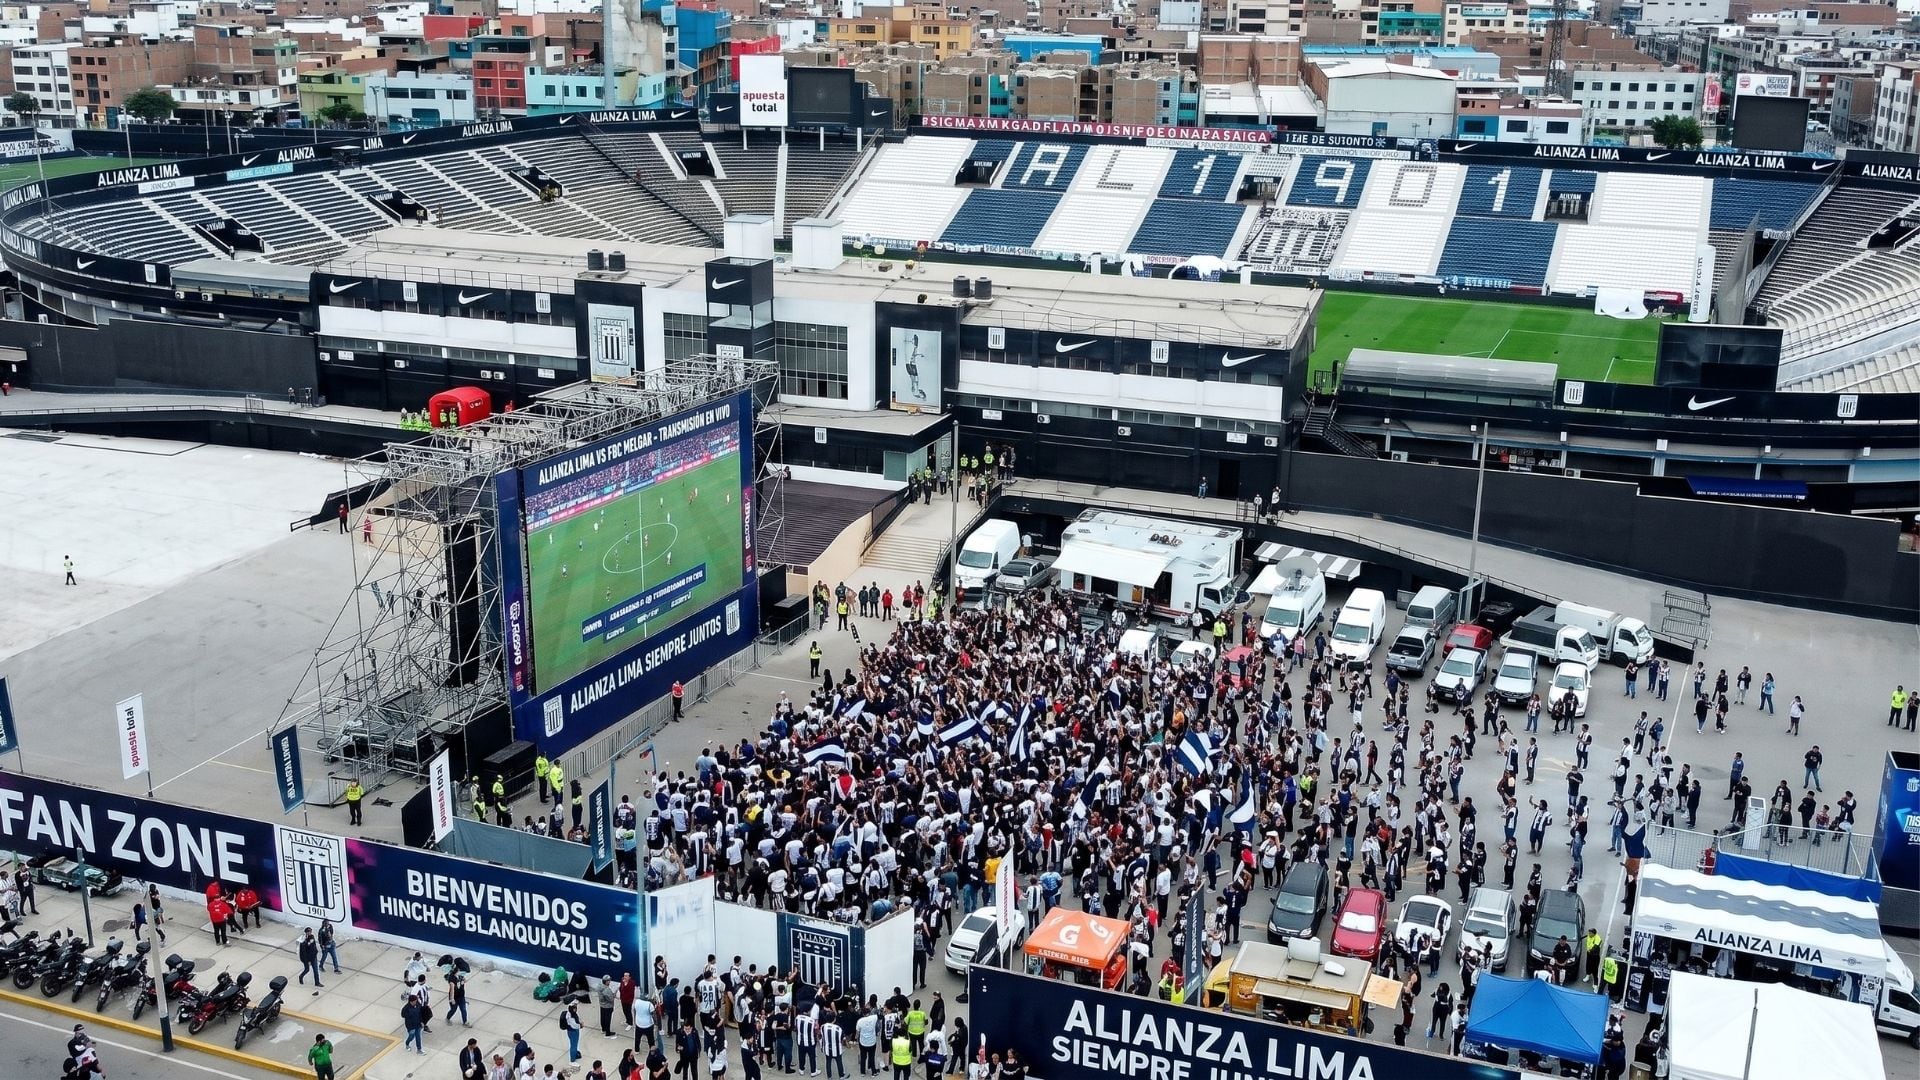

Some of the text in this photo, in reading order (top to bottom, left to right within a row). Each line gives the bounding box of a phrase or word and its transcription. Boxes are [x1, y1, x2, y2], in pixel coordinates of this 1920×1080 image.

[743, 91, 785, 102] apuesta
[590, 110, 657, 123] ALIANZA LIMA
[752, 103, 777, 112] total
[462, 120, 513, 138] ALIANZA LIMA
[278, 136, 383, 163] ALIANZA LIMA
[1534, 145, 1620, 160] ALIANZA LIMA
[1695, 153, 1785, 169] ALIANZA LIMA
[98, 167, 149, 187] ALIANZA
[152, 163, 180, 179] LIMA
[1862, 164, 1913, 180] ALIANZA
[23, 183, 42, 202] LIMA
[539, 459, 574, 486] ALIANZA
[575, 451, 595, 473] LIMA
[596, 446, 607, 465] VS
[607, 442, 622, 461] FBC
[623, 431, 652, 455] MELGAR
[658, 410, 705, 442] TRANSMISIÓN
[705, 409, 715, 426] EN
[715, 403, 730, 422] VIVO
[570, 674, 616, 714] ALIANZA
[617, 657, 644, 687] LIMA
[645, 633, 686, 672] SIEMPRE
[687, 615, 721, 649] JUNTOS
[0, 788, 249, 884] FAN ZONE
[288, 832, 332, 849] ALIANZA
[331, 865, 341, 895] LIMA
[407, 868, 588, 930] BIENVENIDOS
[308, 906, 326, 918] 1901
[380, 895, 622, 962] HINCHAS BLANQUIAZULES
[797, 932, 836, 946] ALIANZA
[1695, 927, 1823, 963] ALIANZA LIMA
[1063, 999, 1376, 1080] ALIANZA LIMA
[1051, 1035, 1192, 1080] SIEMPRE
